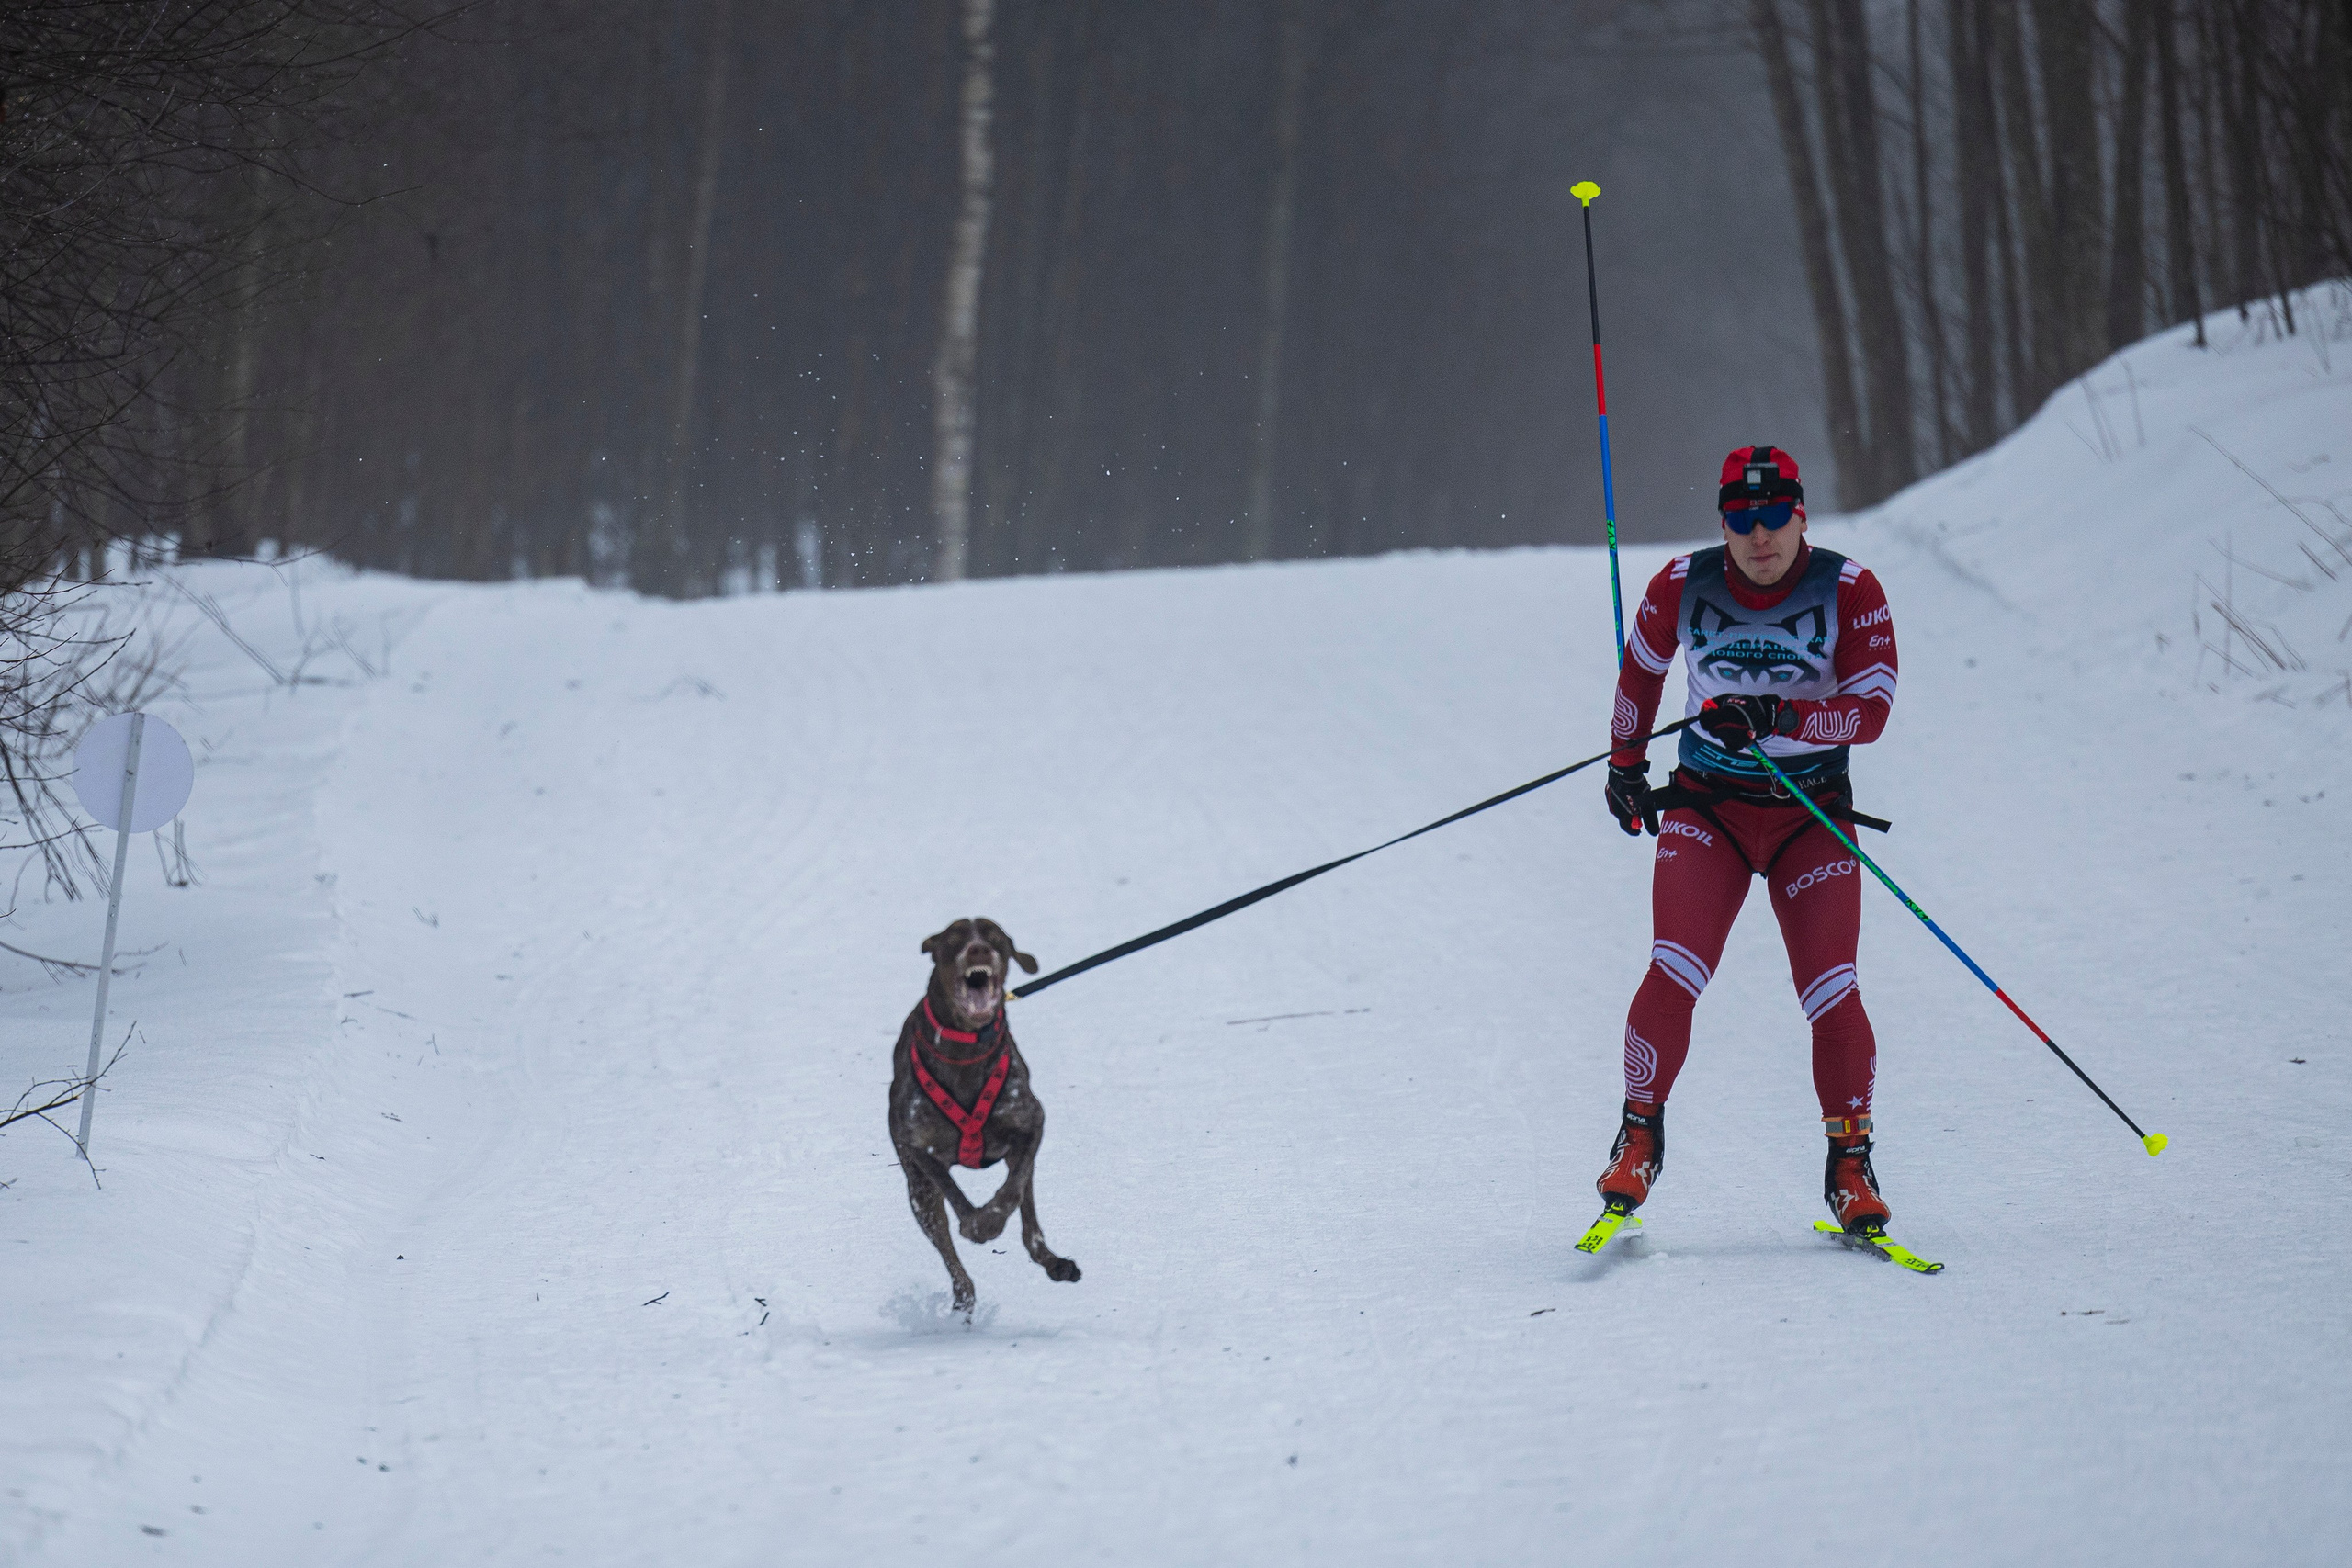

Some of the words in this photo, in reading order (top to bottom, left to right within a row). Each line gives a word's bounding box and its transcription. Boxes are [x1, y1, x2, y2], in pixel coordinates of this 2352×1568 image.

[1869, 634, 1891, 647] En+
[1657, 847, 1678, 859] En+
[1785, 860, 1853, 900] BOSCO
